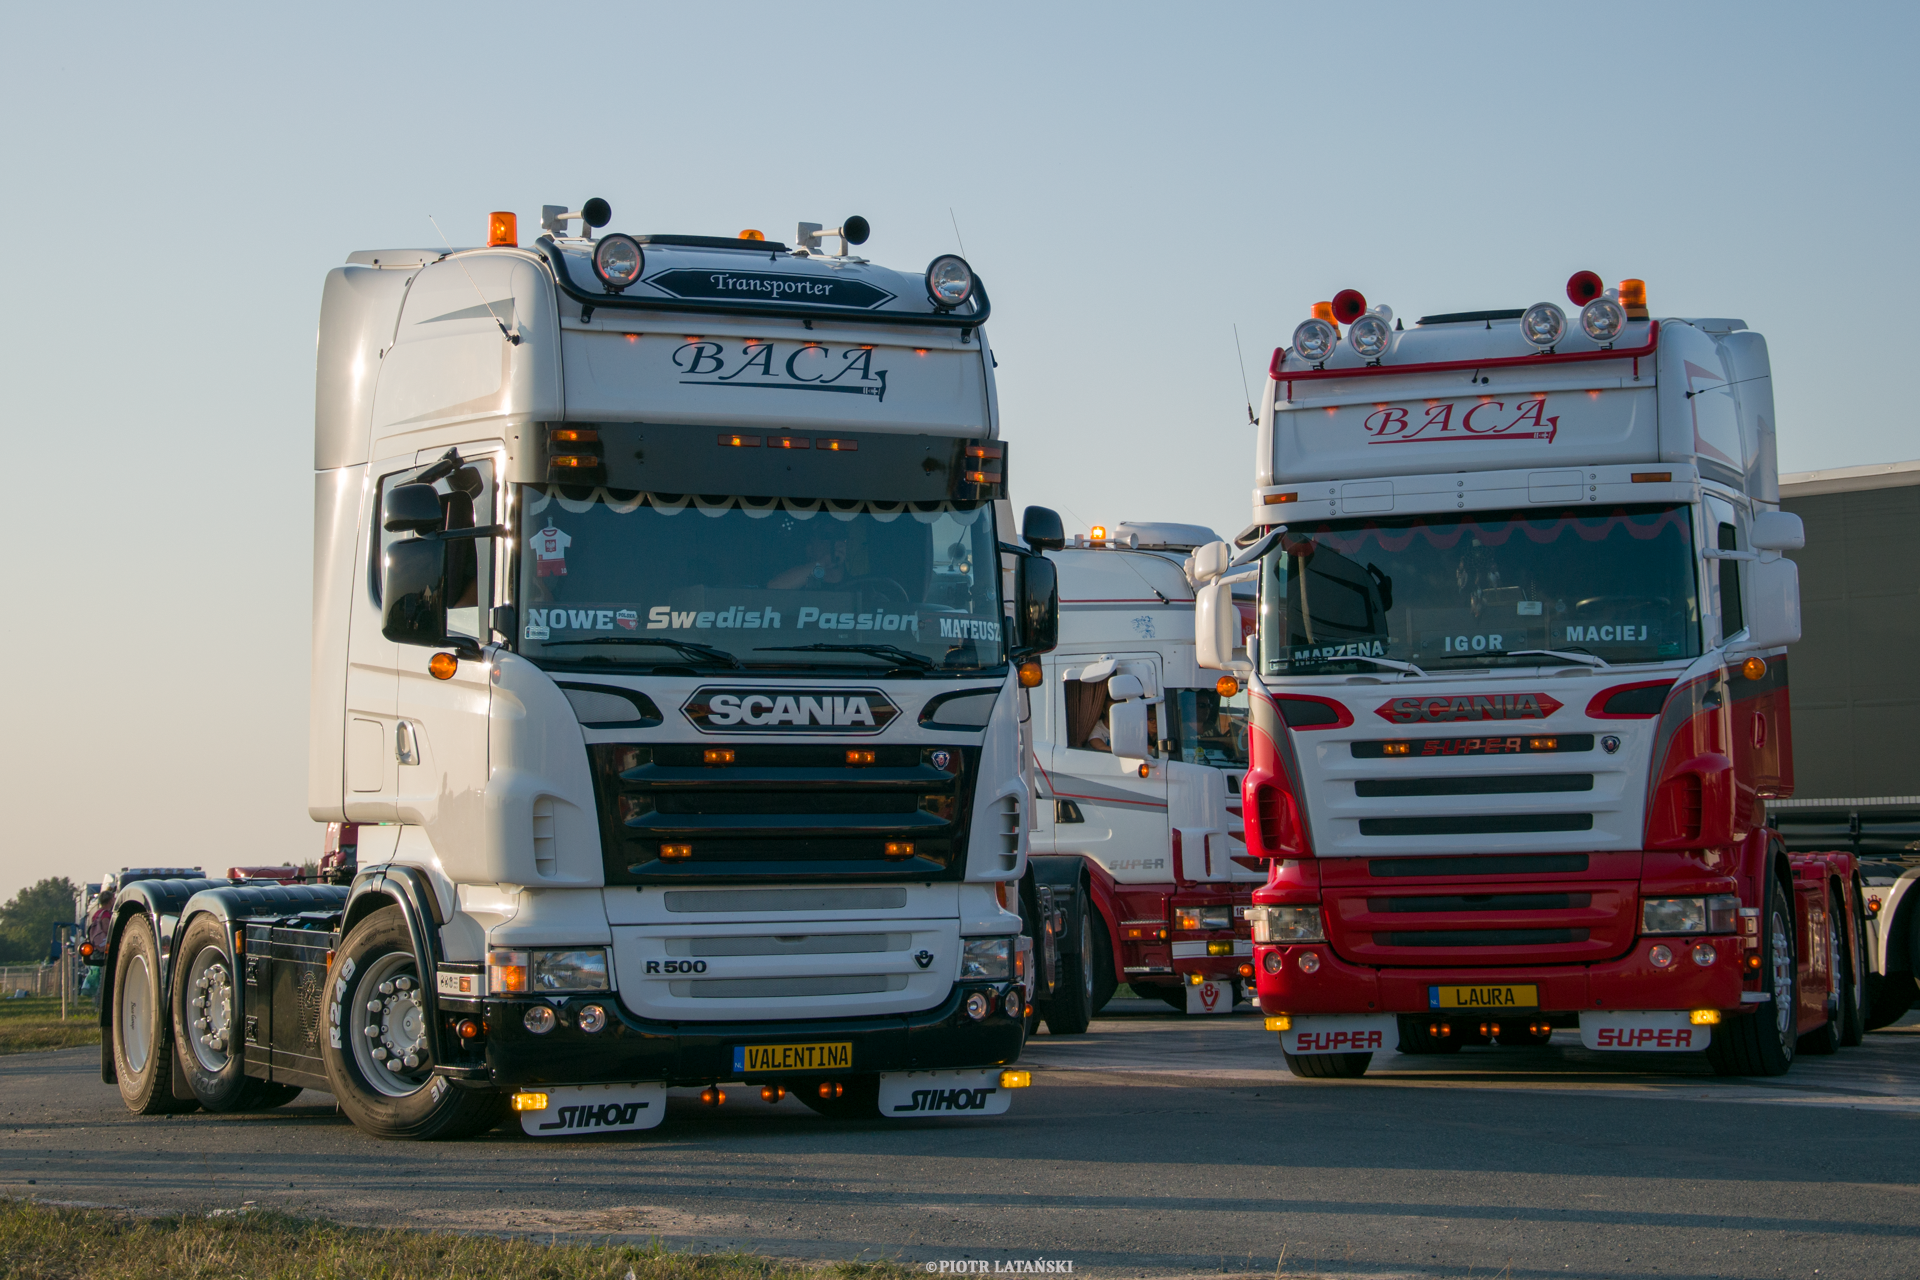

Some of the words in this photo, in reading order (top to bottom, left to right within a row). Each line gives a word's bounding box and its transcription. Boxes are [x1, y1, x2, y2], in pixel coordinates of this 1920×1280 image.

[710, 273, 834, 298] Transporter
[672, 341, 879, 384] BACA
[1364, 398, 1549, 438] BACA
[528, 608, 614, 630] NOWE
[646, 605, 781, 630] Swedish
[796, 606, 919, 632] Passion
[940, 618, 1001, 642] MATEUSZ
[1445, 634, 1503, 652] IGOR
[1566, 625, 1648, 642] MACIEJ
[708, 694, 876, 727] SCANIA
[1392, 694, 1545, 724] SCANIA
[1421, 737, 1521, 756] SUPER
[1109, 858, 1164, 870] SUPER
[646, 960, 661, 974] R
[664, 959, 707, 974] 500
[329, 957, 356, 1049] R249
[1456, 988, 1515, 1006] LAURA
[1297, 1030, 1382, 1051] SUPER
[1597, 1028, 1692, 1047] SUPER
[748, 1045, 848, 1069] VALENTINA
